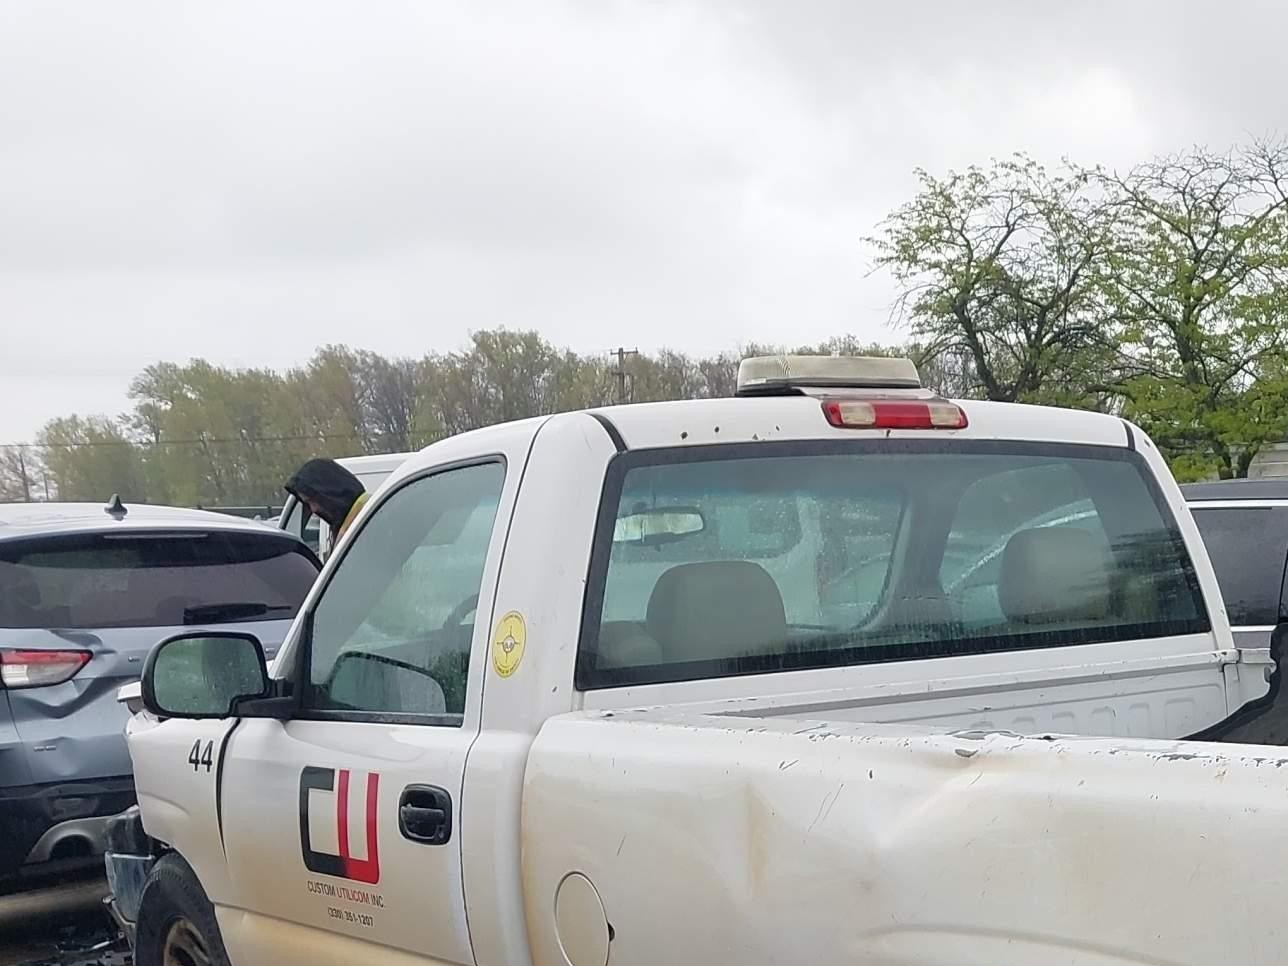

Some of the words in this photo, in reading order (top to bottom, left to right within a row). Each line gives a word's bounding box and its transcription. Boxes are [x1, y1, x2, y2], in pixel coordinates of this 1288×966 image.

[188, 739, 214, 772] 44
[307, 881, 336, 897] CUSTOM
[336, 887, 370, 904] UTILICOM
